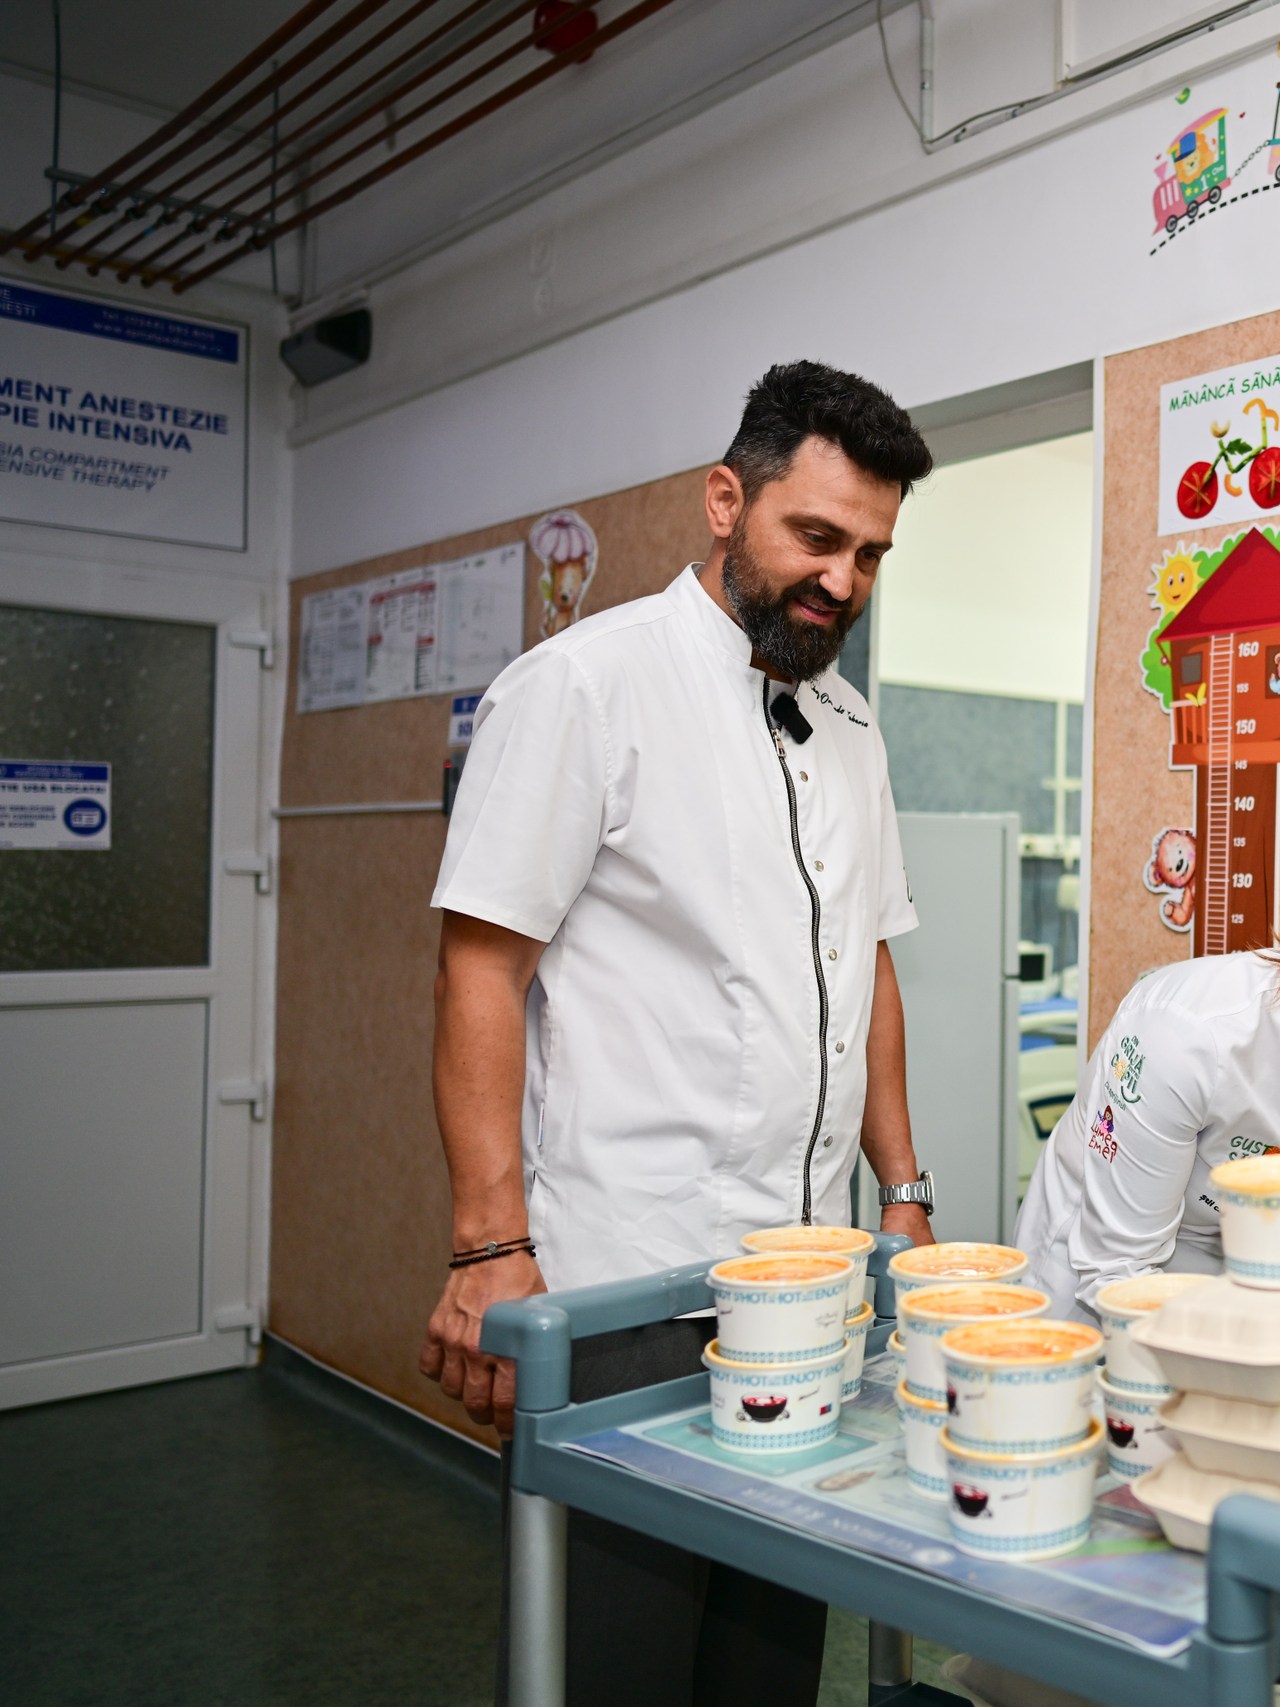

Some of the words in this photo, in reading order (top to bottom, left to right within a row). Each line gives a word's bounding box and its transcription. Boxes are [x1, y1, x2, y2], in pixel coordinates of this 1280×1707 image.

[1201, 175, 1208, 191] 1
[79, 391, 229, 435] ANESTEZIE
[49, 411, 192, 452] INTENSIVA
[29, 447, 171, 480] COMPARTMENT
[72, 469, 157, 493] THERAPY
[1238, 642, 1259, 657] 160
[1235, 719, 1256, 734] 150
[1234, 760, 1247, 770] 145
[1234, 797, 1255, 811] 140
[1233, 837, 1246, 848] 135
[1232, 874, 1253, 888] 130
[1231, 914, 1244, 924] 125
